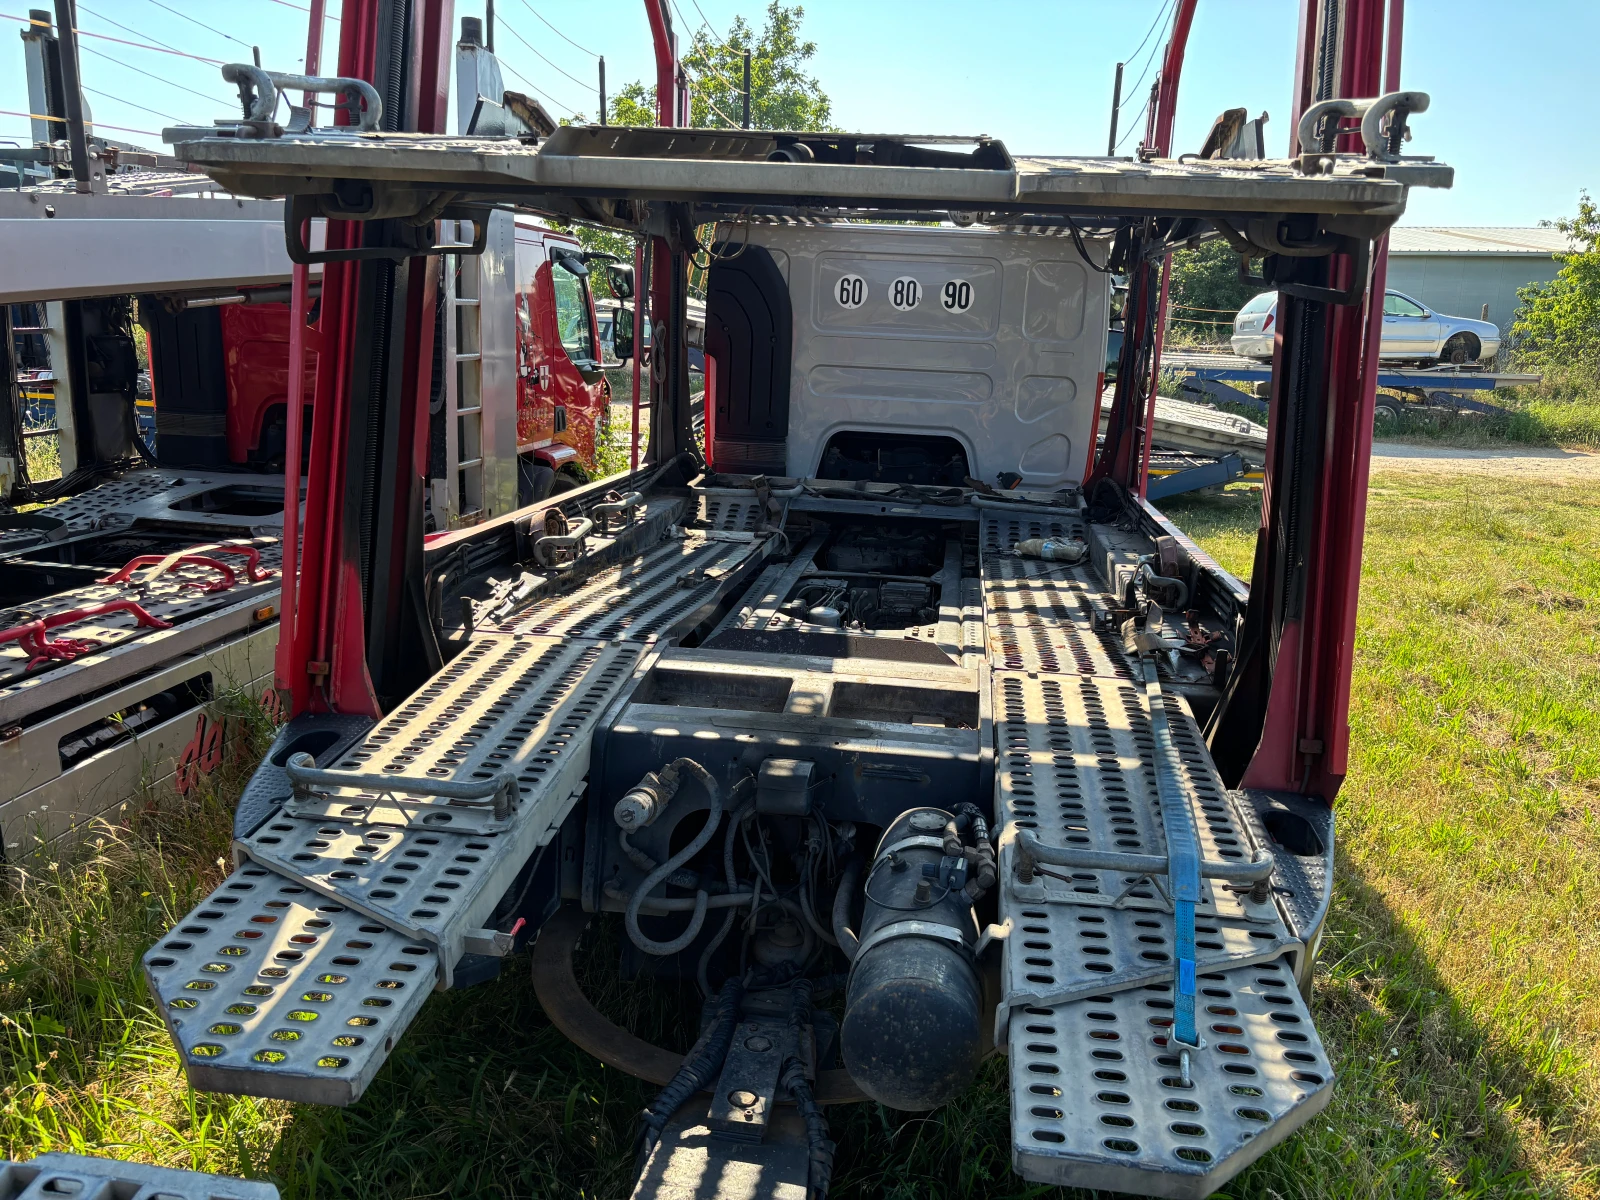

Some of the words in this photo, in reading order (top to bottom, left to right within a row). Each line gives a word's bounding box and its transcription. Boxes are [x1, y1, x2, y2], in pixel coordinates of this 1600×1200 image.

[840, 278, 863, 305] 60
[893, 280, 917, 307] 80
[944, 282, 971, 309] 90
